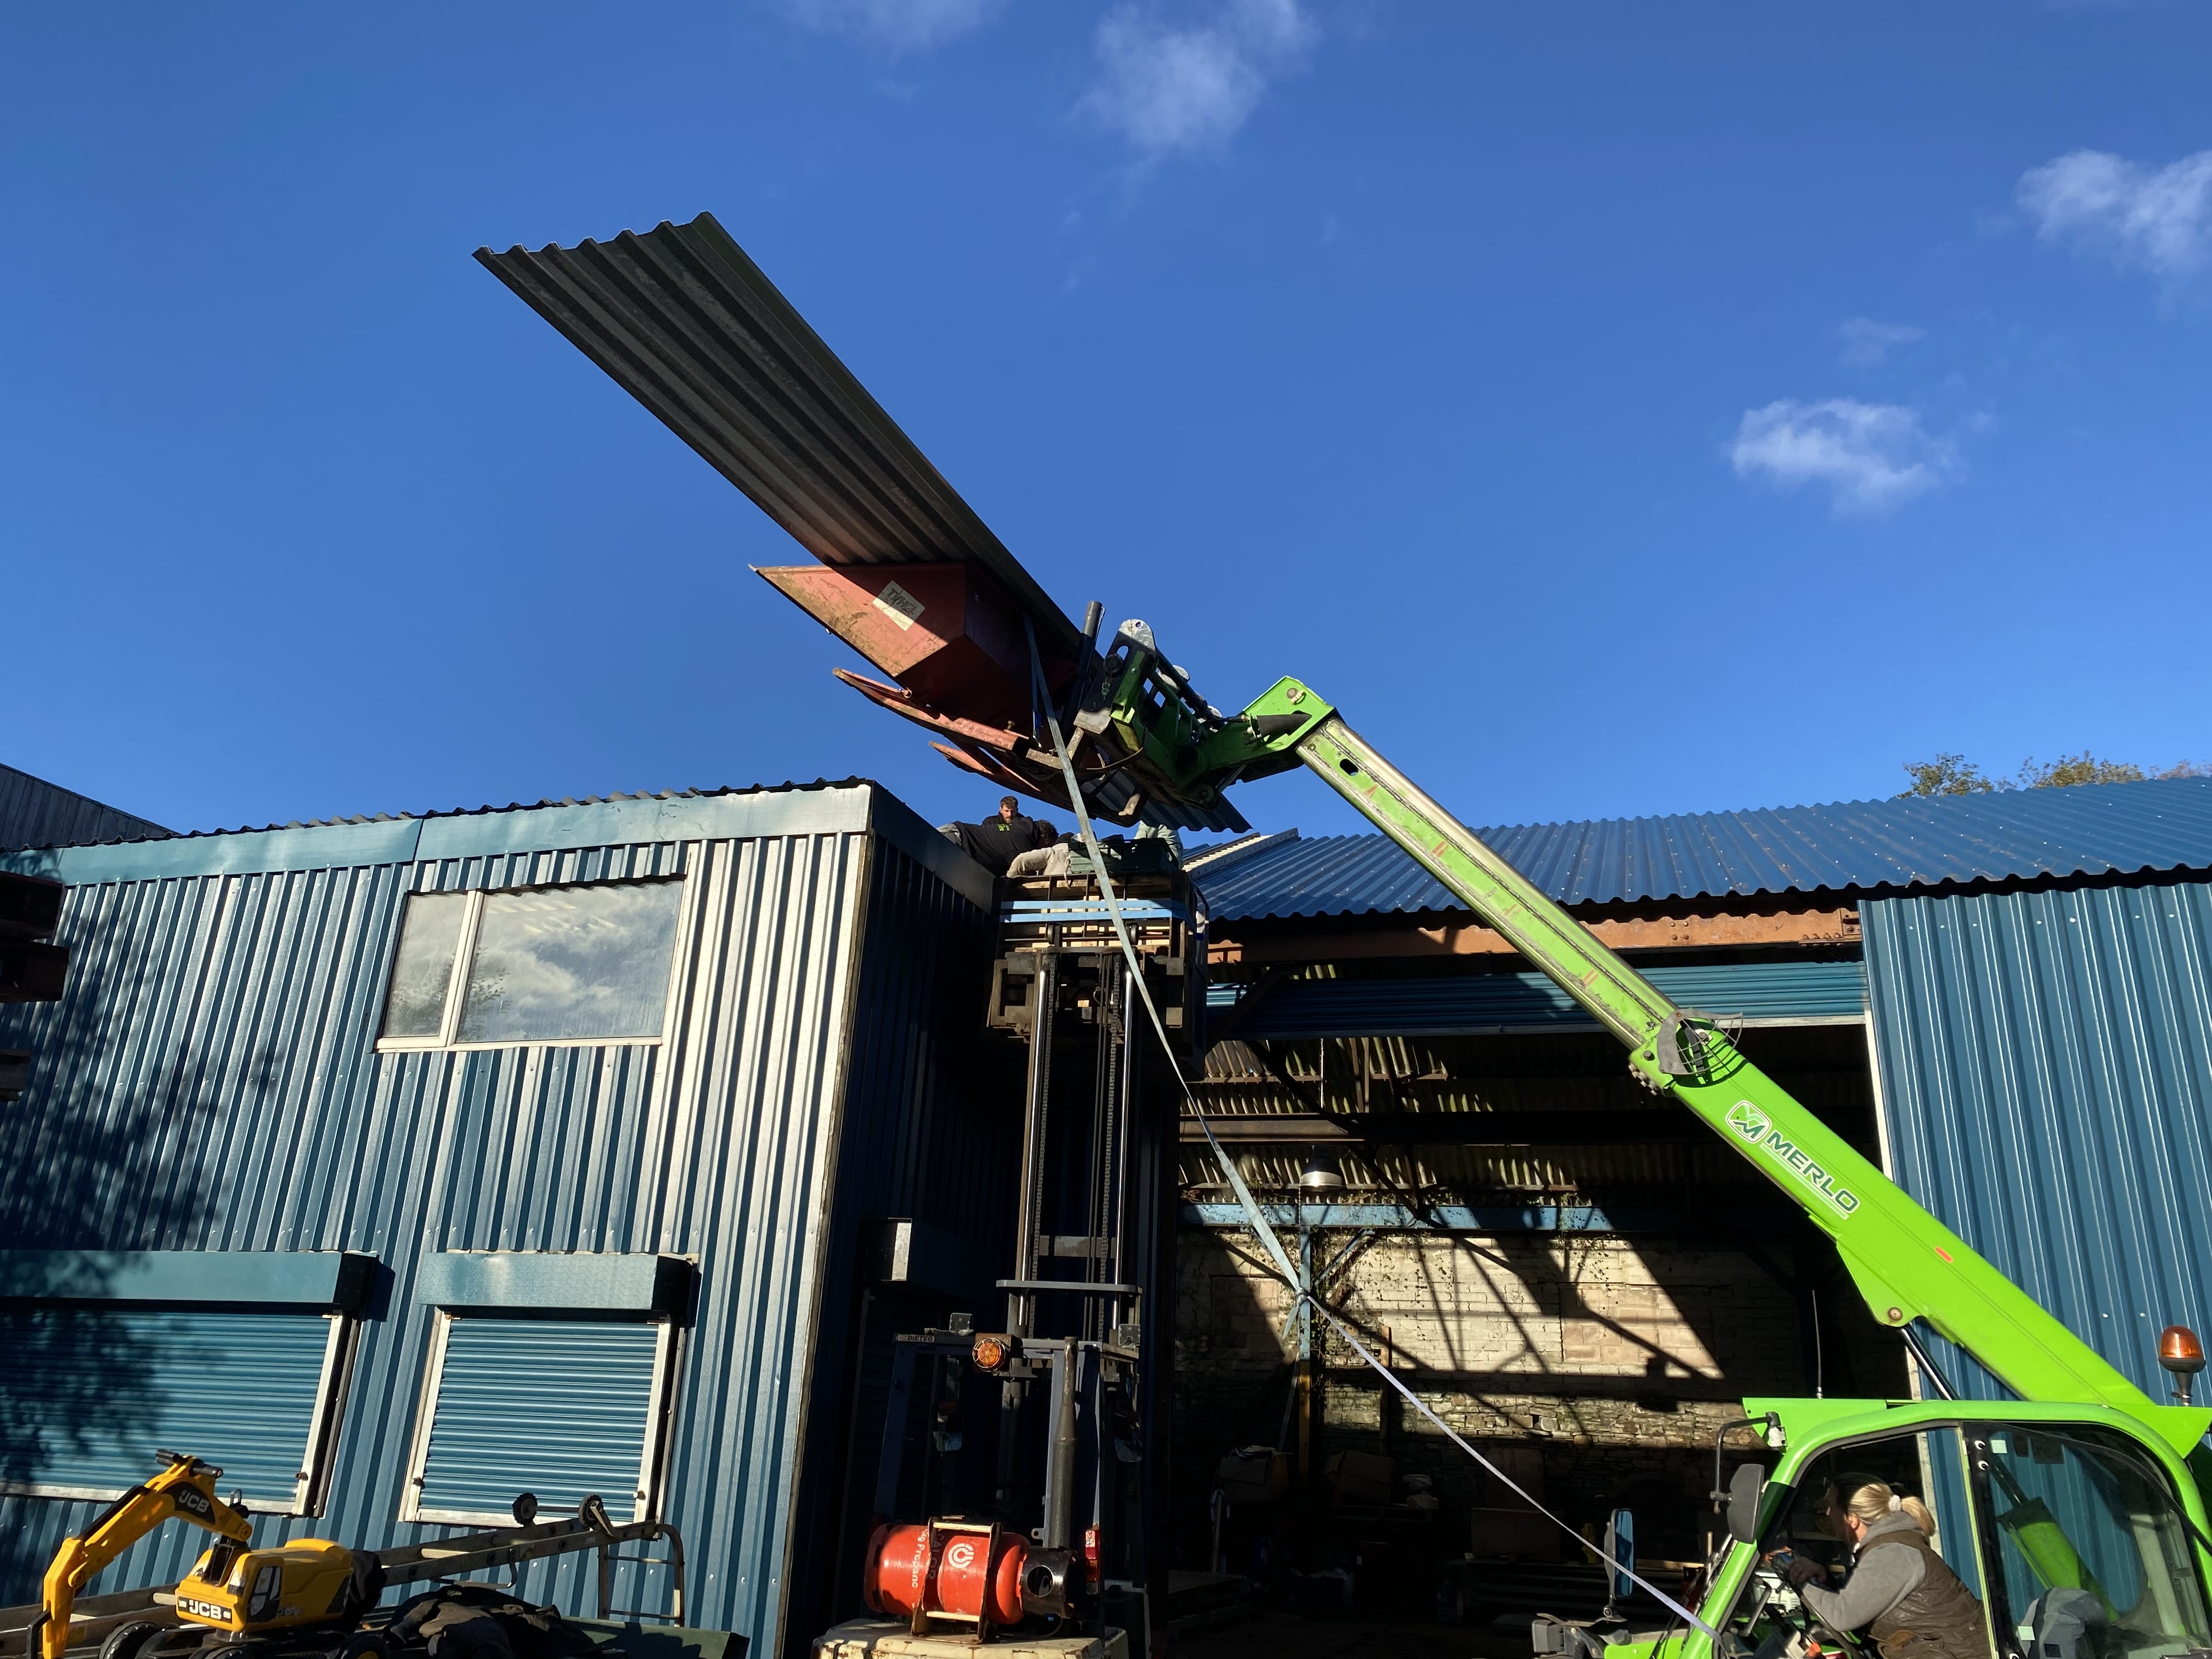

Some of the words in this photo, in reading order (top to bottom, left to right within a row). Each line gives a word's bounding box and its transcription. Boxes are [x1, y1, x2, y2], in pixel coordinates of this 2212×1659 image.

[1765, 1130, 1860, 1213] MERLO
[178, 1489, 210, 1513] JCB
[911, 1544, 926, 1588] Propane
[189, 1599, 222, 1620] JCB
